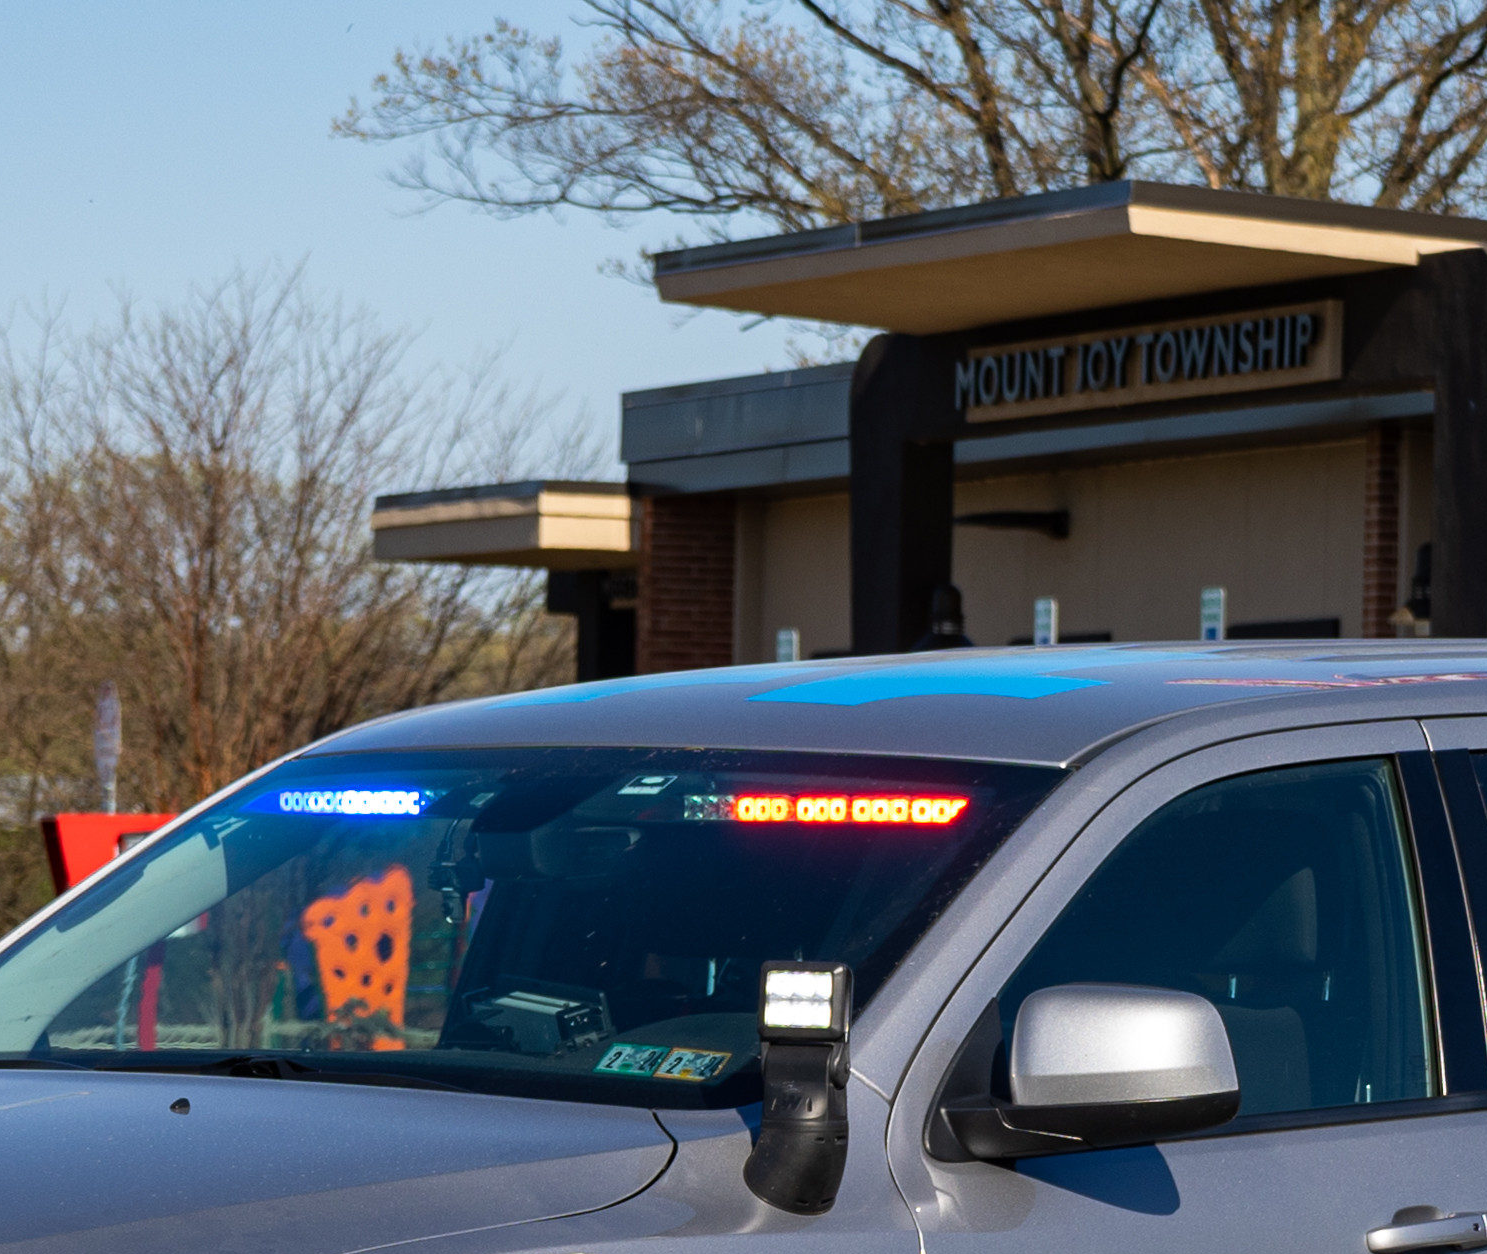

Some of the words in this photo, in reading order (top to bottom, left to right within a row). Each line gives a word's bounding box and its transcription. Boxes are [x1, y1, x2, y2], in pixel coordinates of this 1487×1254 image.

[954, 345, 1065, 409] MOUNT
[1075, 335, 1132, 393] JOY
[1134, 312, 1313, 384] TOWNSHIP
